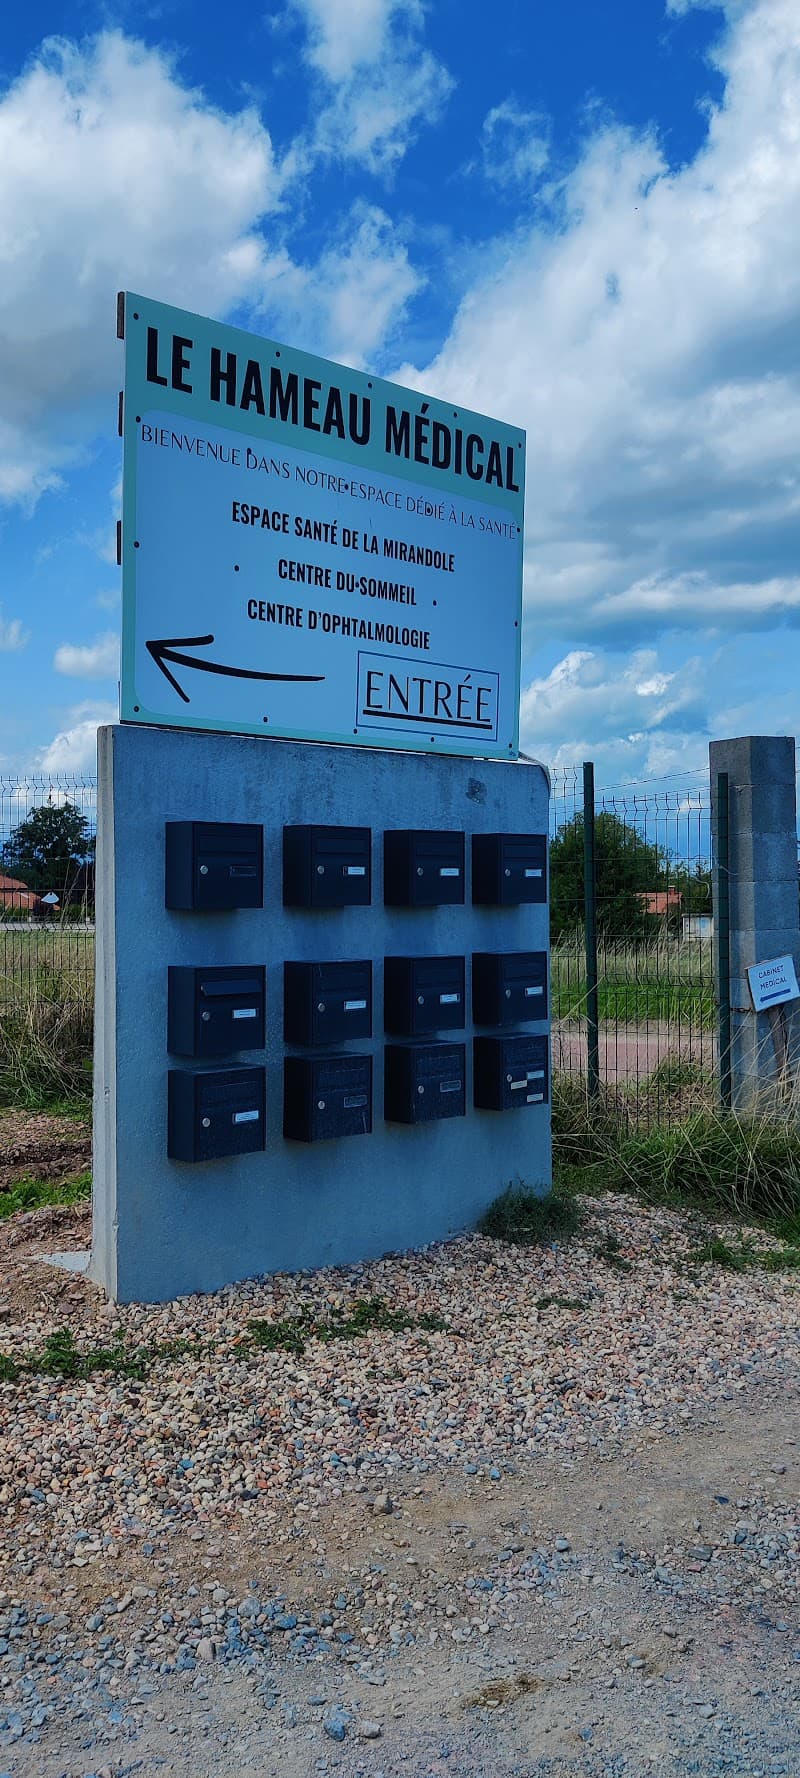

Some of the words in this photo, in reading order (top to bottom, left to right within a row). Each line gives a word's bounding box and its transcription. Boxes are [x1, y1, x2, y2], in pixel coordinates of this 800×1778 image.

[146, 327, 193, 393] LE
[210, 347, 371, 446] HAMEAU
[385, 403, 519, 493] MÉDICAL
[141, 424, 241, 466] BIENVENUE
[246, 450, 290, 479] DANS
[295, 466, 345, 494] NOTRE
[350, 482, 402, 509] ESPACE
[406, 496, 445, 521] DÉDIÉ
[449, 505, 457, 523] À
[461, 512, 475, 529] LA
[479, 516, 516, 540] SANTÉ
[232, 501, 289, 534] ESPACE
[295, 517, 338, 545] SANTÉ
[343, 530, 359, 549] DE
[363, 534, 379, 555] LA
[383, 539, 455, 572] MIRANDOLE
[278, 559, 331, 588] CENTRE
[336, 571, 355, 592] DU
[359, 576, 416, 606] SOMMEIL
[247, 599, 303, 627] CENTRE
[308, 611, 430, 650] D'OPHTALMOLOGIE
[366, 670, 492, 723] ENTRÉE
